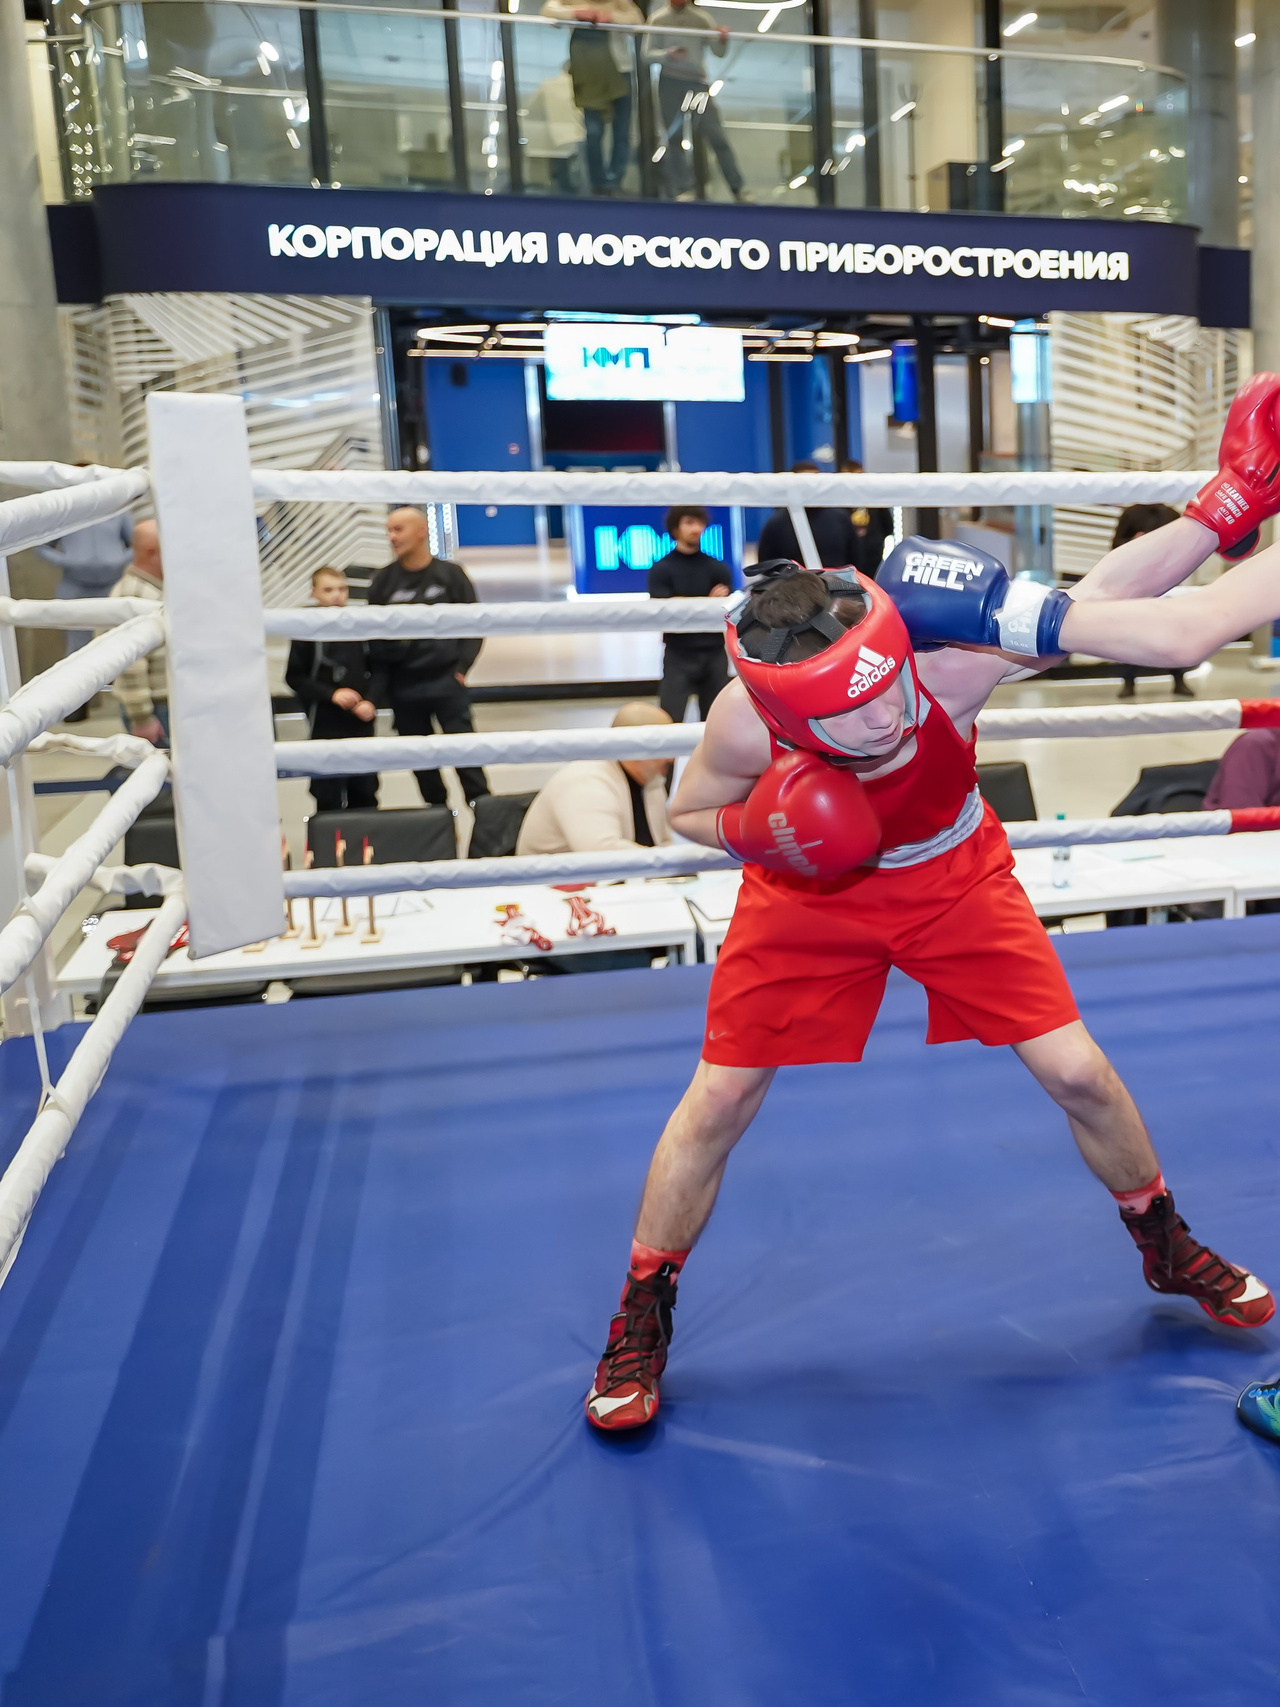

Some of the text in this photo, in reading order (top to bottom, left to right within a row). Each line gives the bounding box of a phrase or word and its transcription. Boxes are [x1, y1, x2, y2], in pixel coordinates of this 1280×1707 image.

[268, 223, 1130, 281] КОРПОРАЦИЯ МОРСКОГО ПРИБОРОСТРОЕНИЯ
[1223, 497, 1243, 518] PUNCH
[1226, 486, 1250, 512] LEATHER
[905, 551, 985, 577] GREEN
[902, 565, 965, 592] HILL
[847, 655, 896, 698] adidas
[766, 812, 822, 877] clinch
